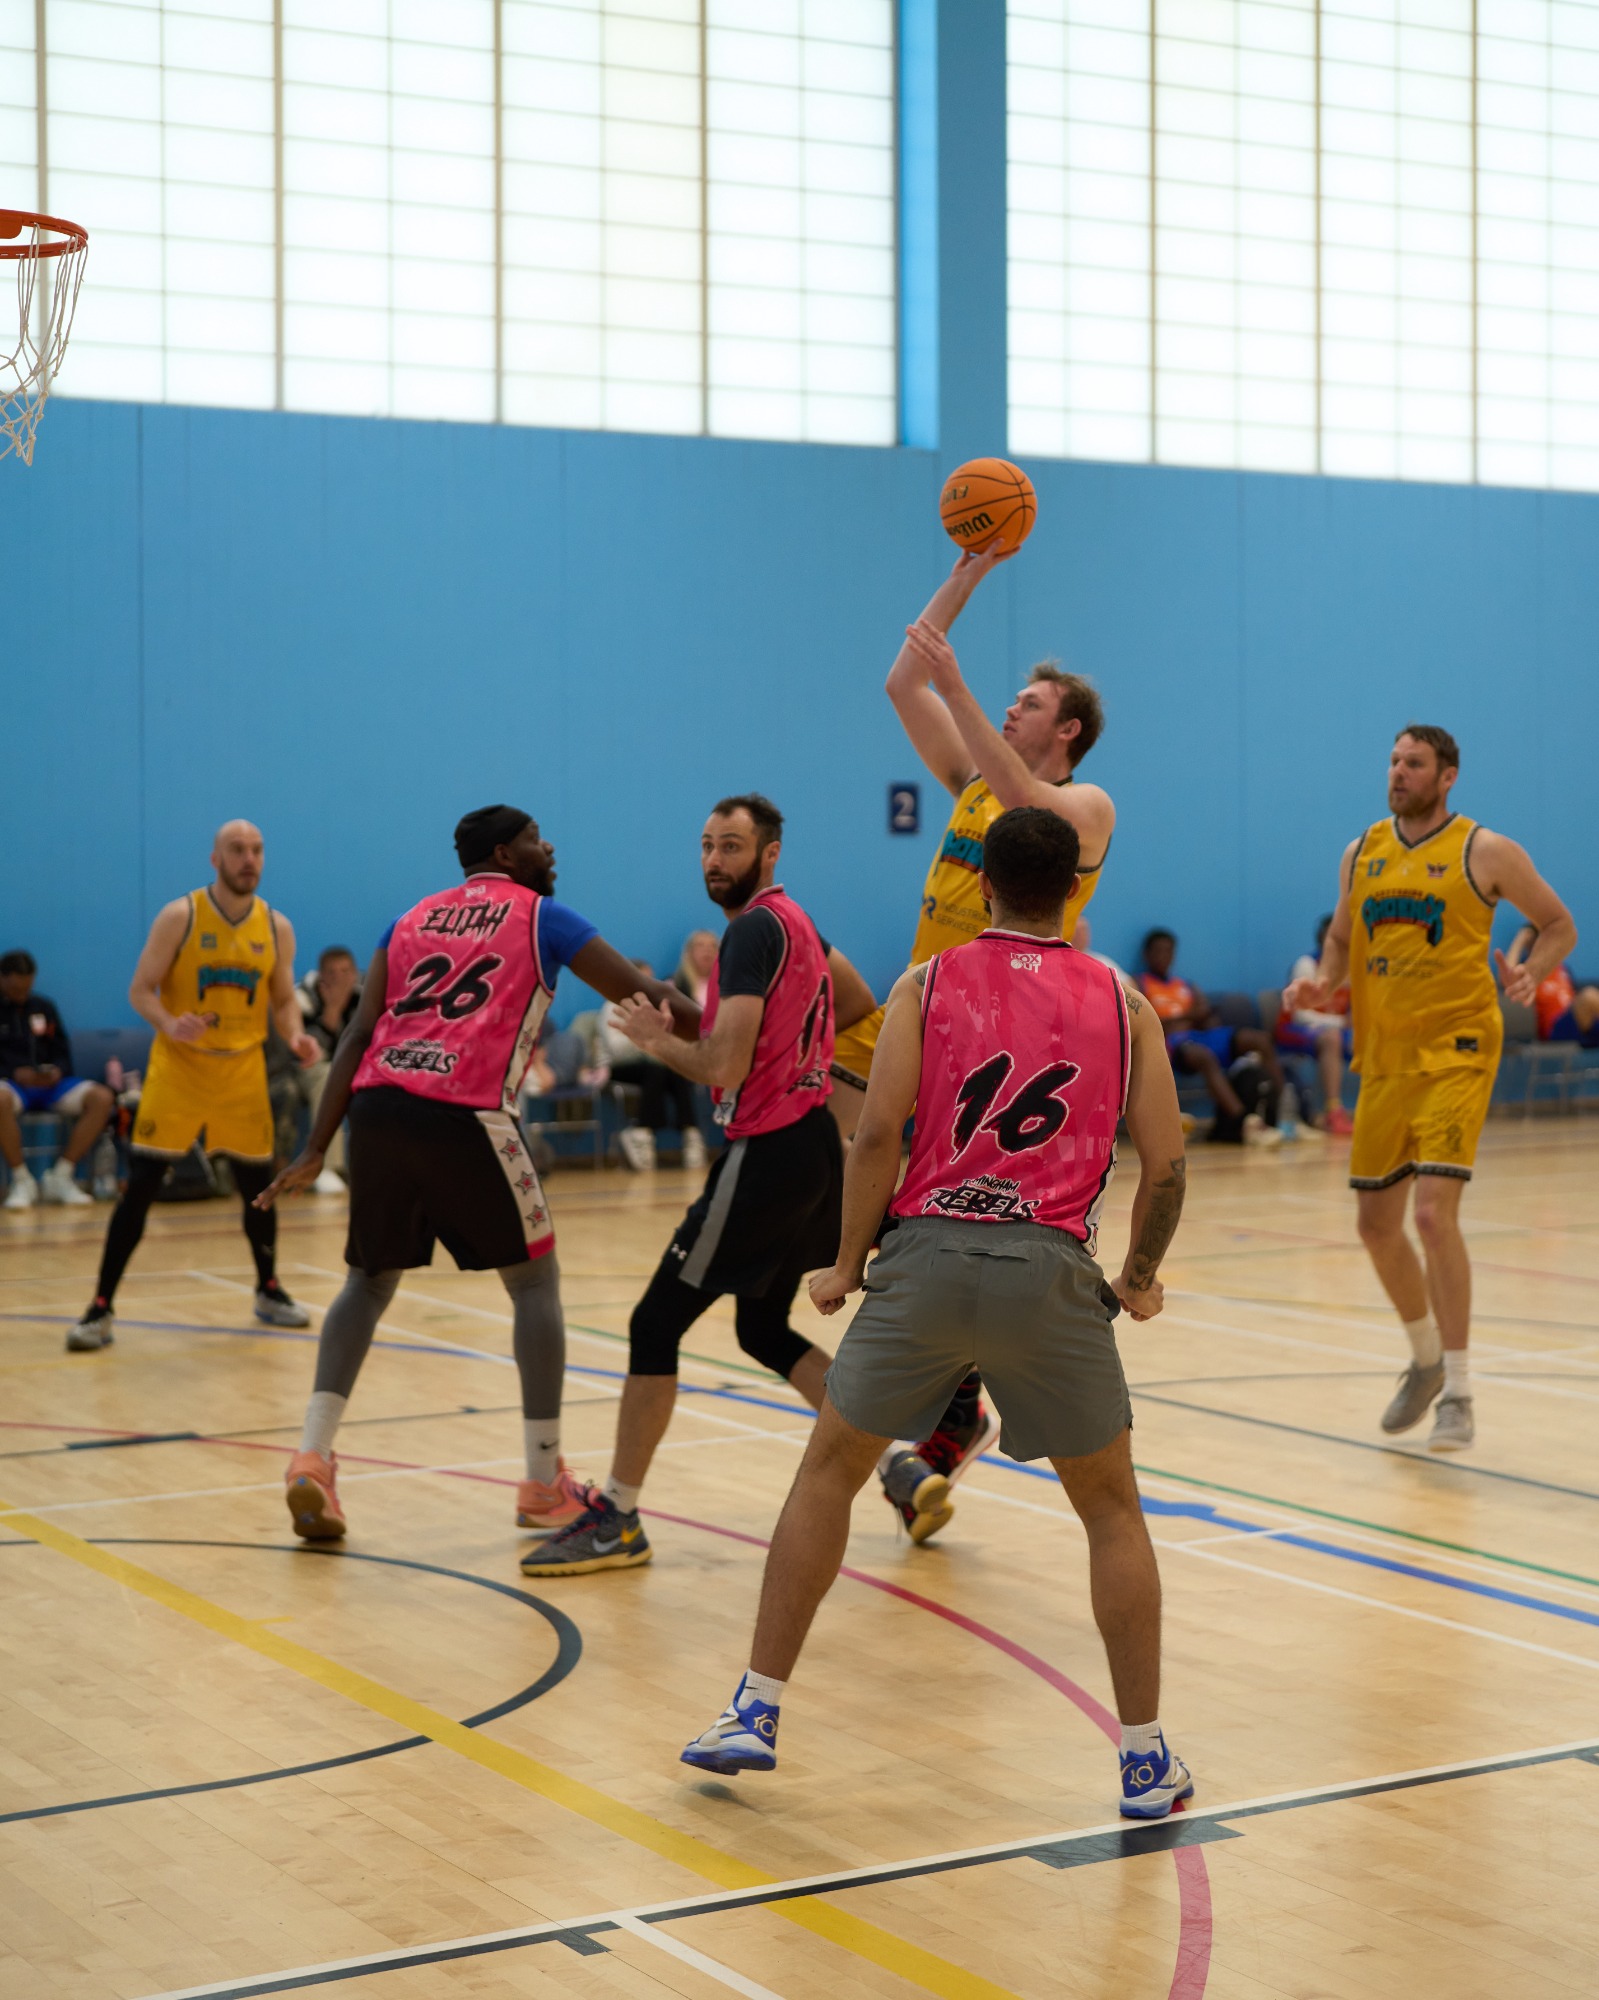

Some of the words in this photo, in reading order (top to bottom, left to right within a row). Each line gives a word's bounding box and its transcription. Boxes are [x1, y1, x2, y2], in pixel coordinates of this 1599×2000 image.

[893, 790, 916, 829] 2
[1367, 858, 1386, 877] 17
[417, 897, 514, 943] ELIJAH
[389, 951, 505, 1022] 26
[380, 1046, 459, 1075] REBELS
[949, 1050, 1082, 1164] 16
[921, 1187, 1043, 1221] REBELS
